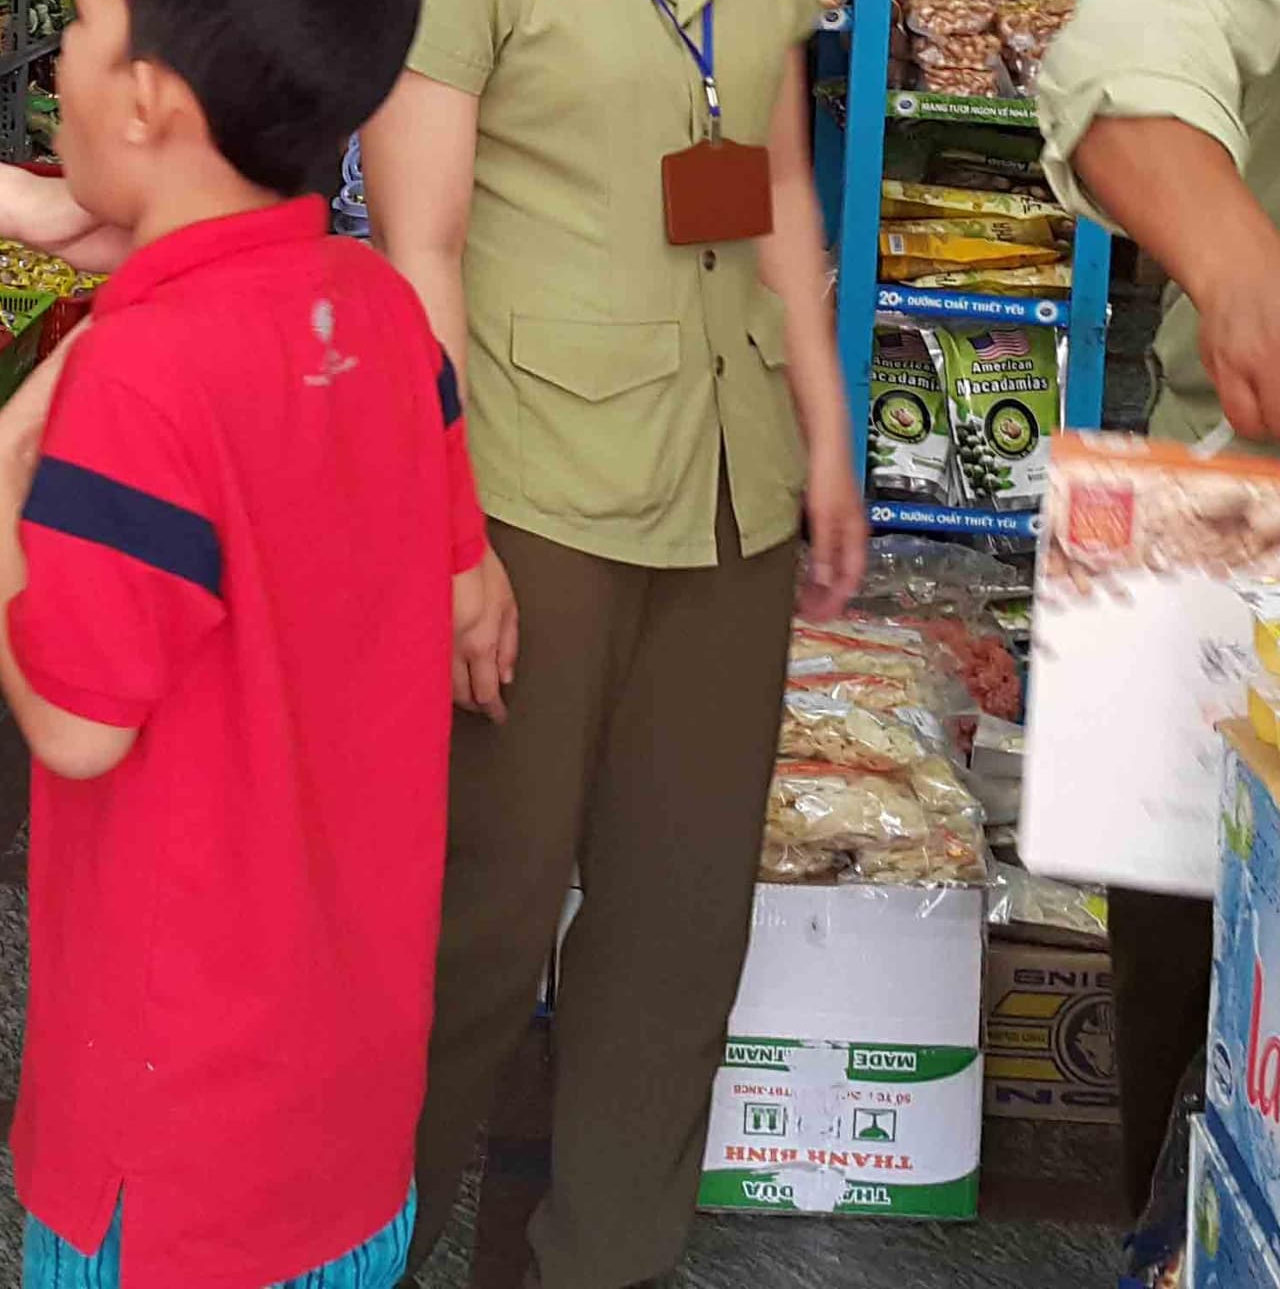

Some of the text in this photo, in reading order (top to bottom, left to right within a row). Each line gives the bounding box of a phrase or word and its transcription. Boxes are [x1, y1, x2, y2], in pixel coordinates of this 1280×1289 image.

[971, 360, 1033, 374] American
[956, 375, 1048, 396] Macadamias
[855, 1051, 916, 1069] MADE
